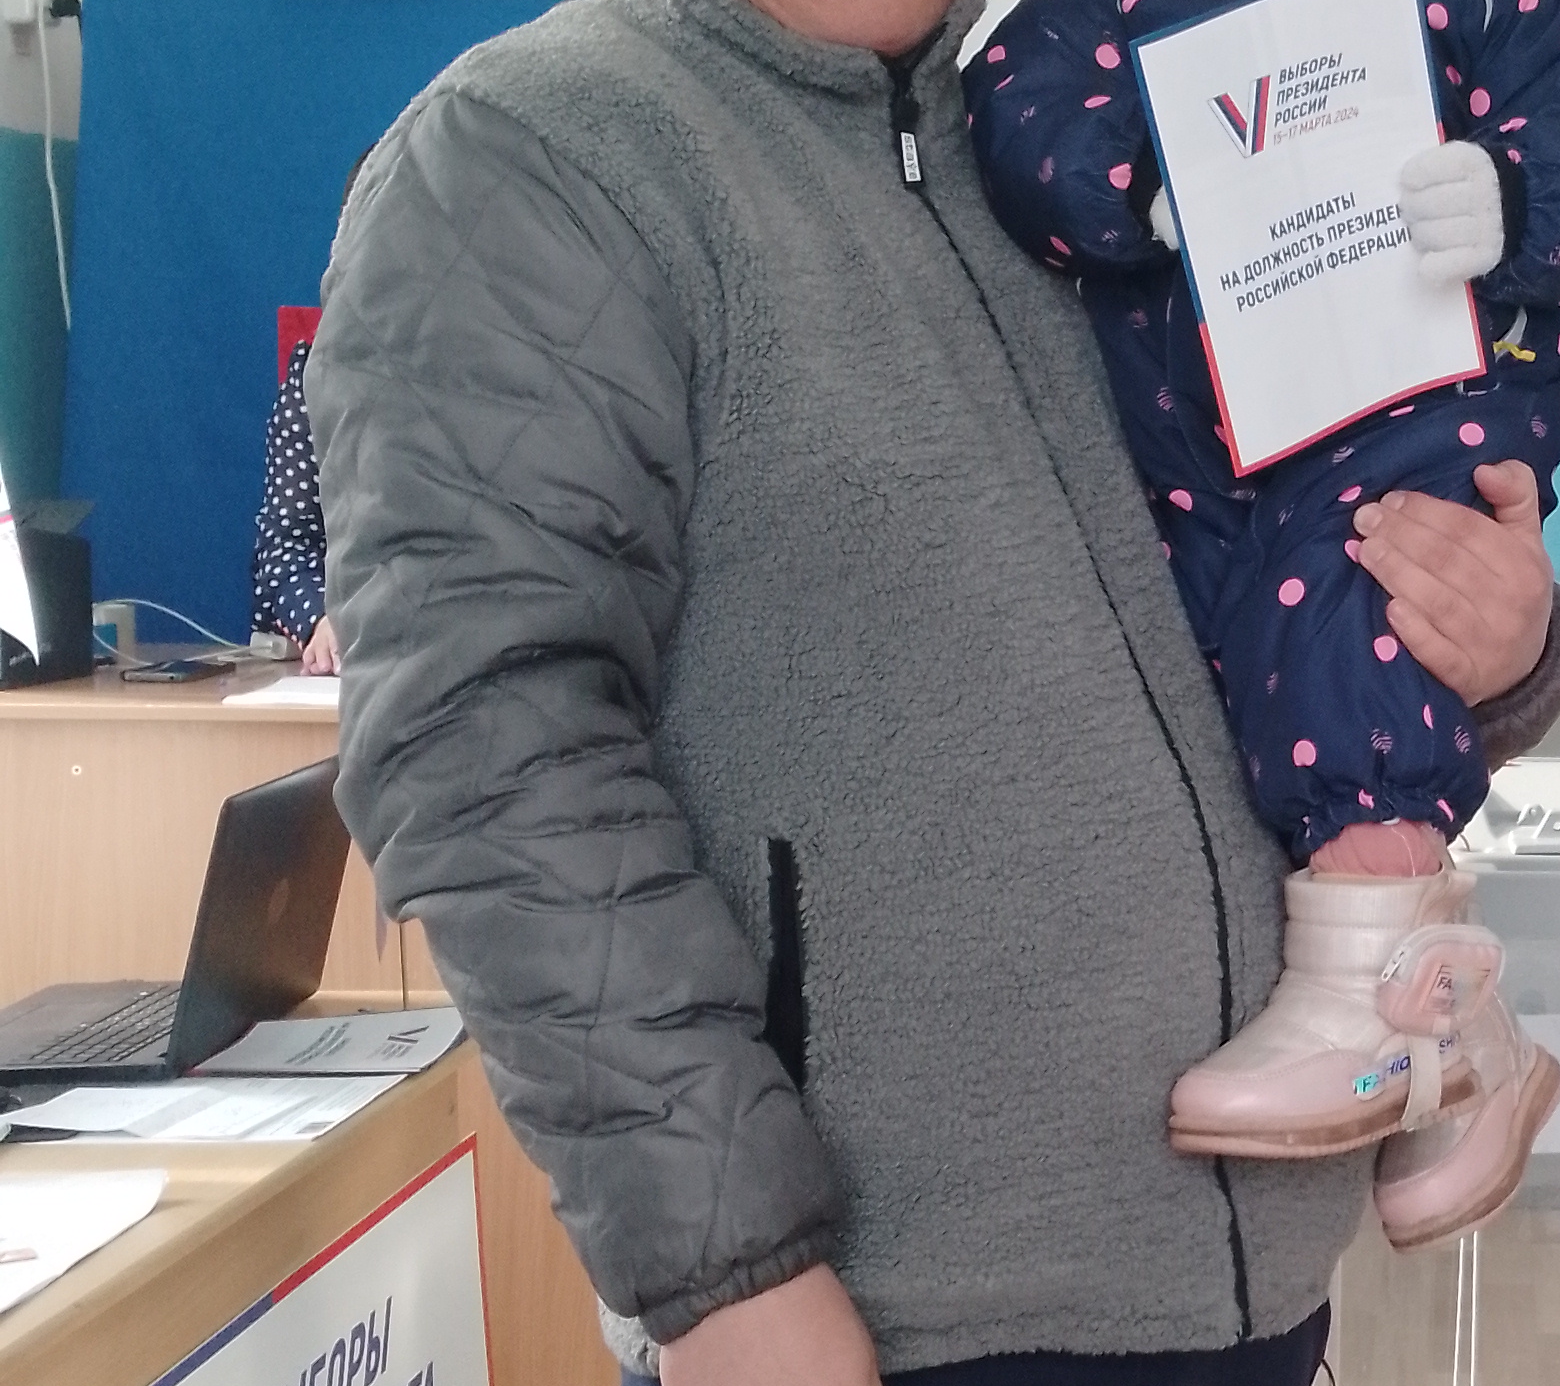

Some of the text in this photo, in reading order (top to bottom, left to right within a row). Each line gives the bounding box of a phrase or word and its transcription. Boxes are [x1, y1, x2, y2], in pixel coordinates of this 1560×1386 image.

[1276, 67, 1366, 106] ПРЕЗИДЕНТА
[1278, 53, 1342, 84] ВЫБОРЫ
[1274, 95, 1328, 128] РОССИИ
[1299, 113, 1332, 135] МАРТА
[1334, 106, 1359, 124] 2024
[1269, 192, 1356, 241] КАНДИДАТЫ
[1220, 270, 1241, 291] НА
[1244, 232, 1325, 285] ДОЛЖНОСТЬ
[1236, 254, 1325, 312] РОССИЙСКОЙ
